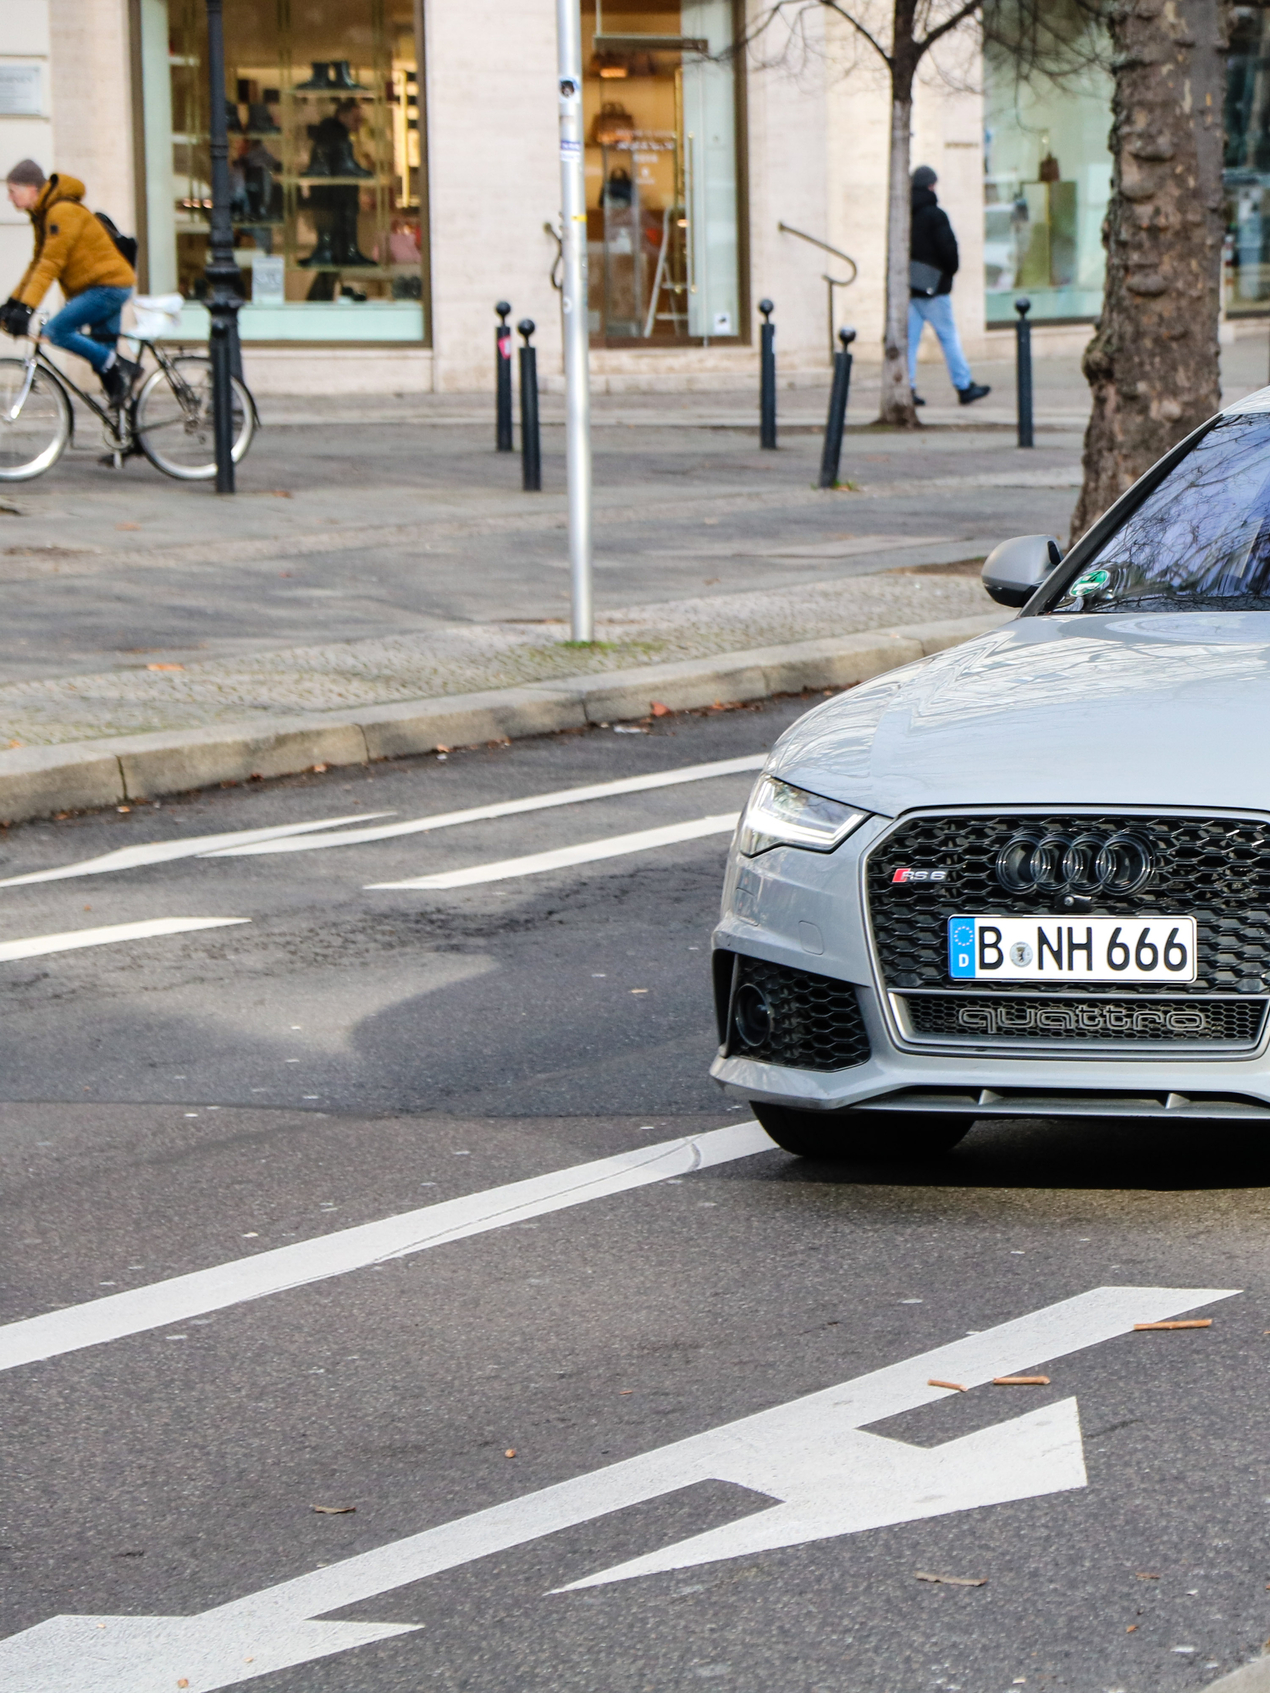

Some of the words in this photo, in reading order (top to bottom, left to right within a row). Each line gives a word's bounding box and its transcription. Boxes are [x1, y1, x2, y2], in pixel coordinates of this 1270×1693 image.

[959, 954, 969, 968] D
[979, 926, 1004, 970] B
[1037, 926, 1093, 971] NH
[1107, 927, 1188, 972] 666
[958, 1005, 1206, 1034] quattro
